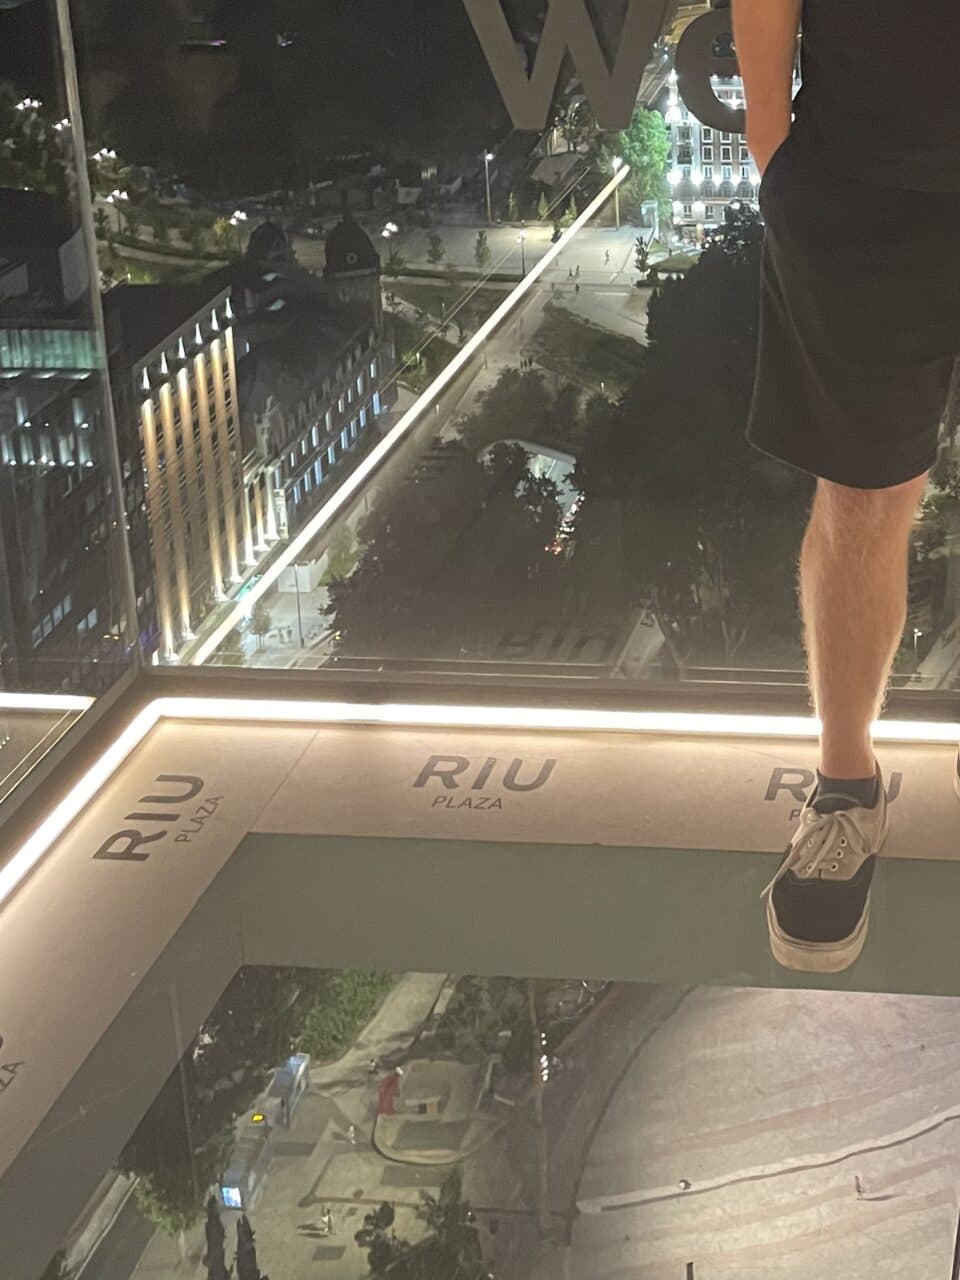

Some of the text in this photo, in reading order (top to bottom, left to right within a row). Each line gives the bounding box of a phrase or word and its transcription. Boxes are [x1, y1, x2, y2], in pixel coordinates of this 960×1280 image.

[412, 754, 558, 792] RIU
[92, 774, 205, 861] RIU
[173, 796, 225, 843] PLAZA
[431, 795, 504, 810] PLAZA
